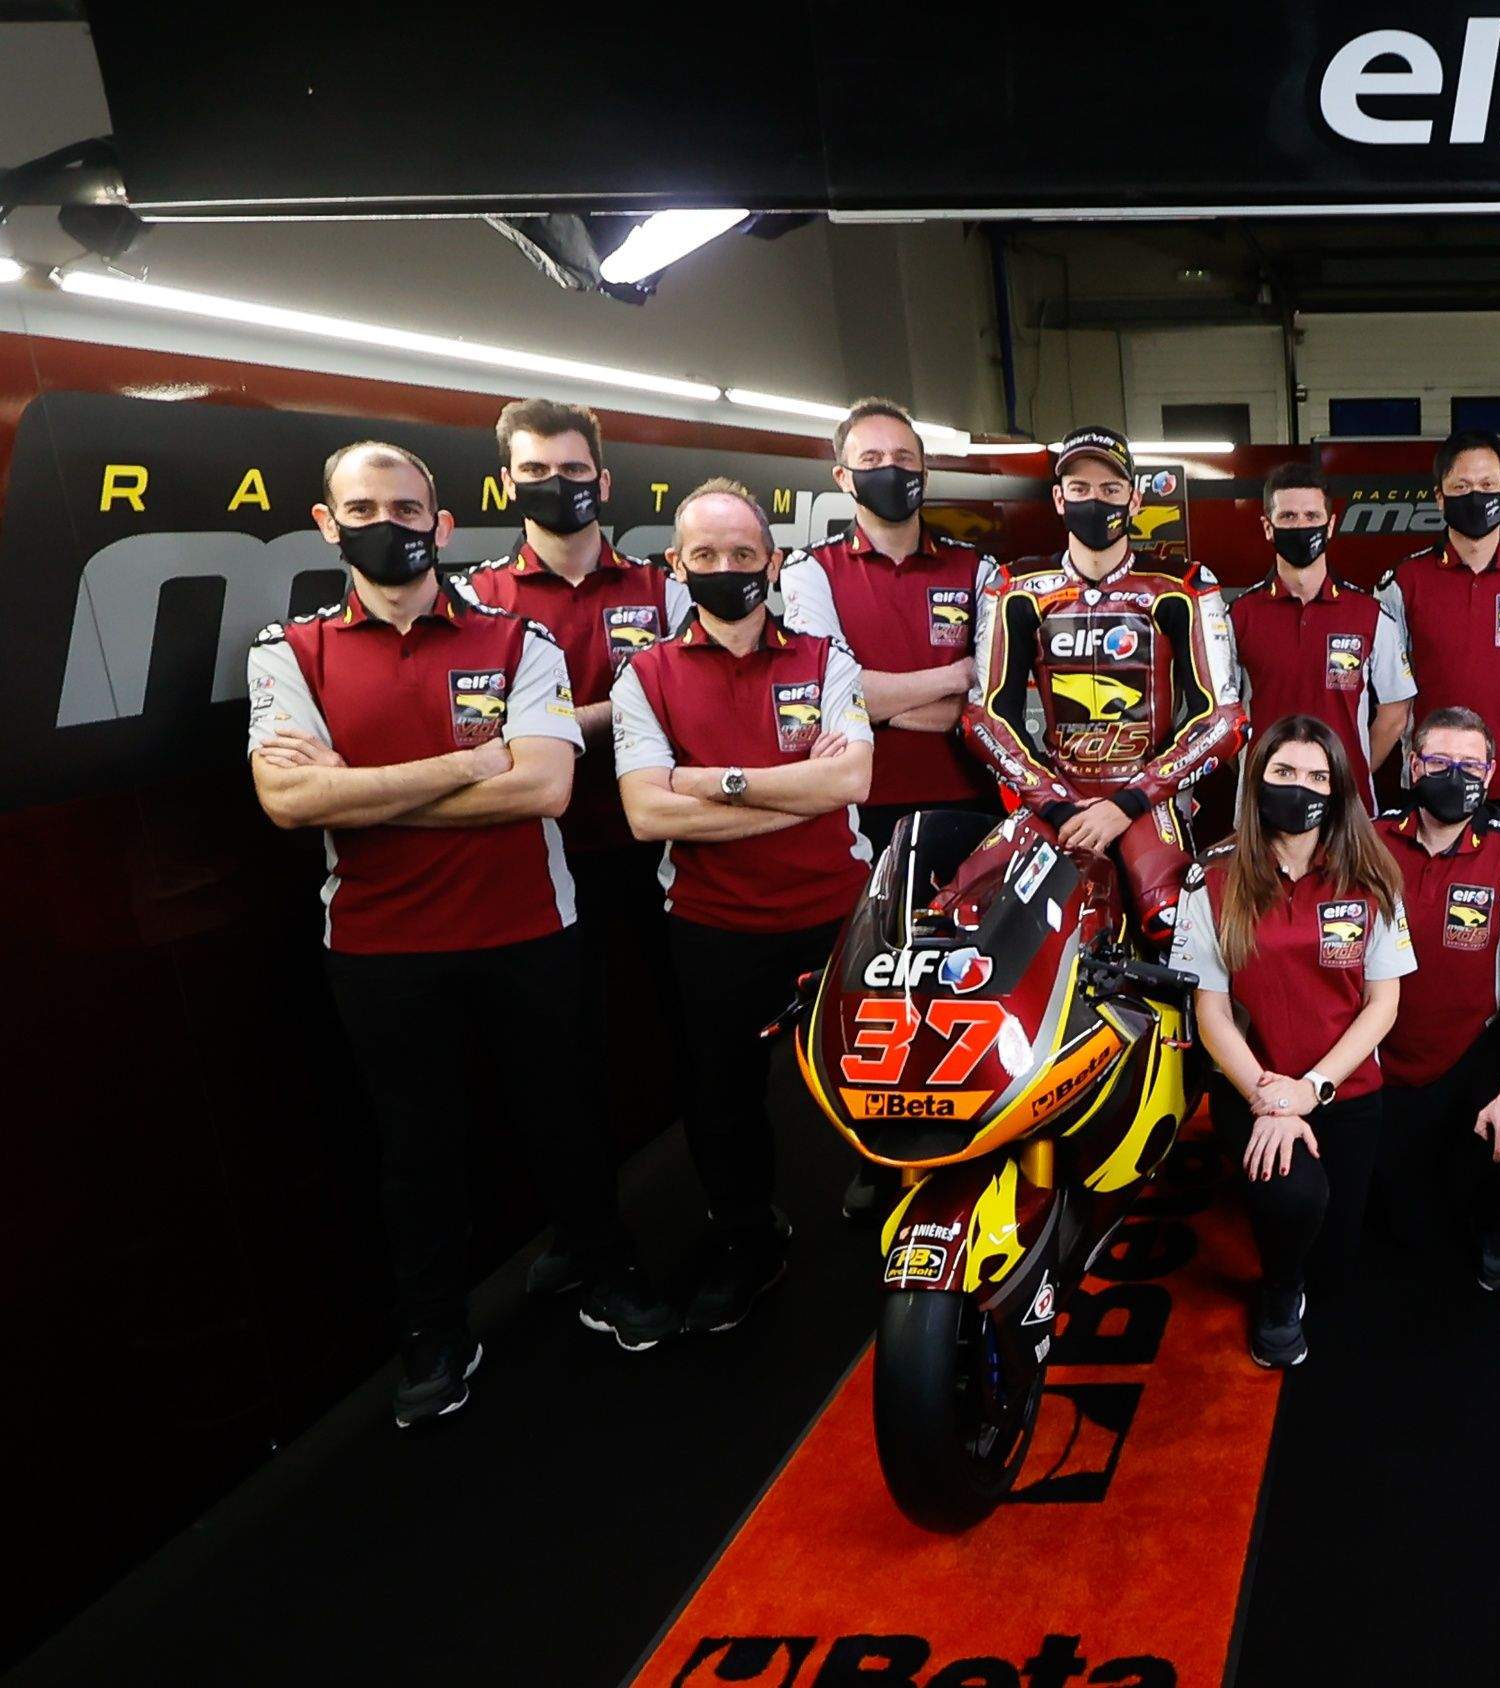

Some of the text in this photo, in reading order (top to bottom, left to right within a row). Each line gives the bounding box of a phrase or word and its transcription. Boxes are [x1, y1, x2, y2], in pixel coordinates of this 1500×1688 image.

[1051, 629, 1104, 657] elf
[456, 675, 490, 689] elf
[864, 951, 940, 988] elf
[840, 998, 1008, 1085] 37
[1055, 1046, 1110, 1101] Beta
[885, 1093, 954, 1117] Beta
